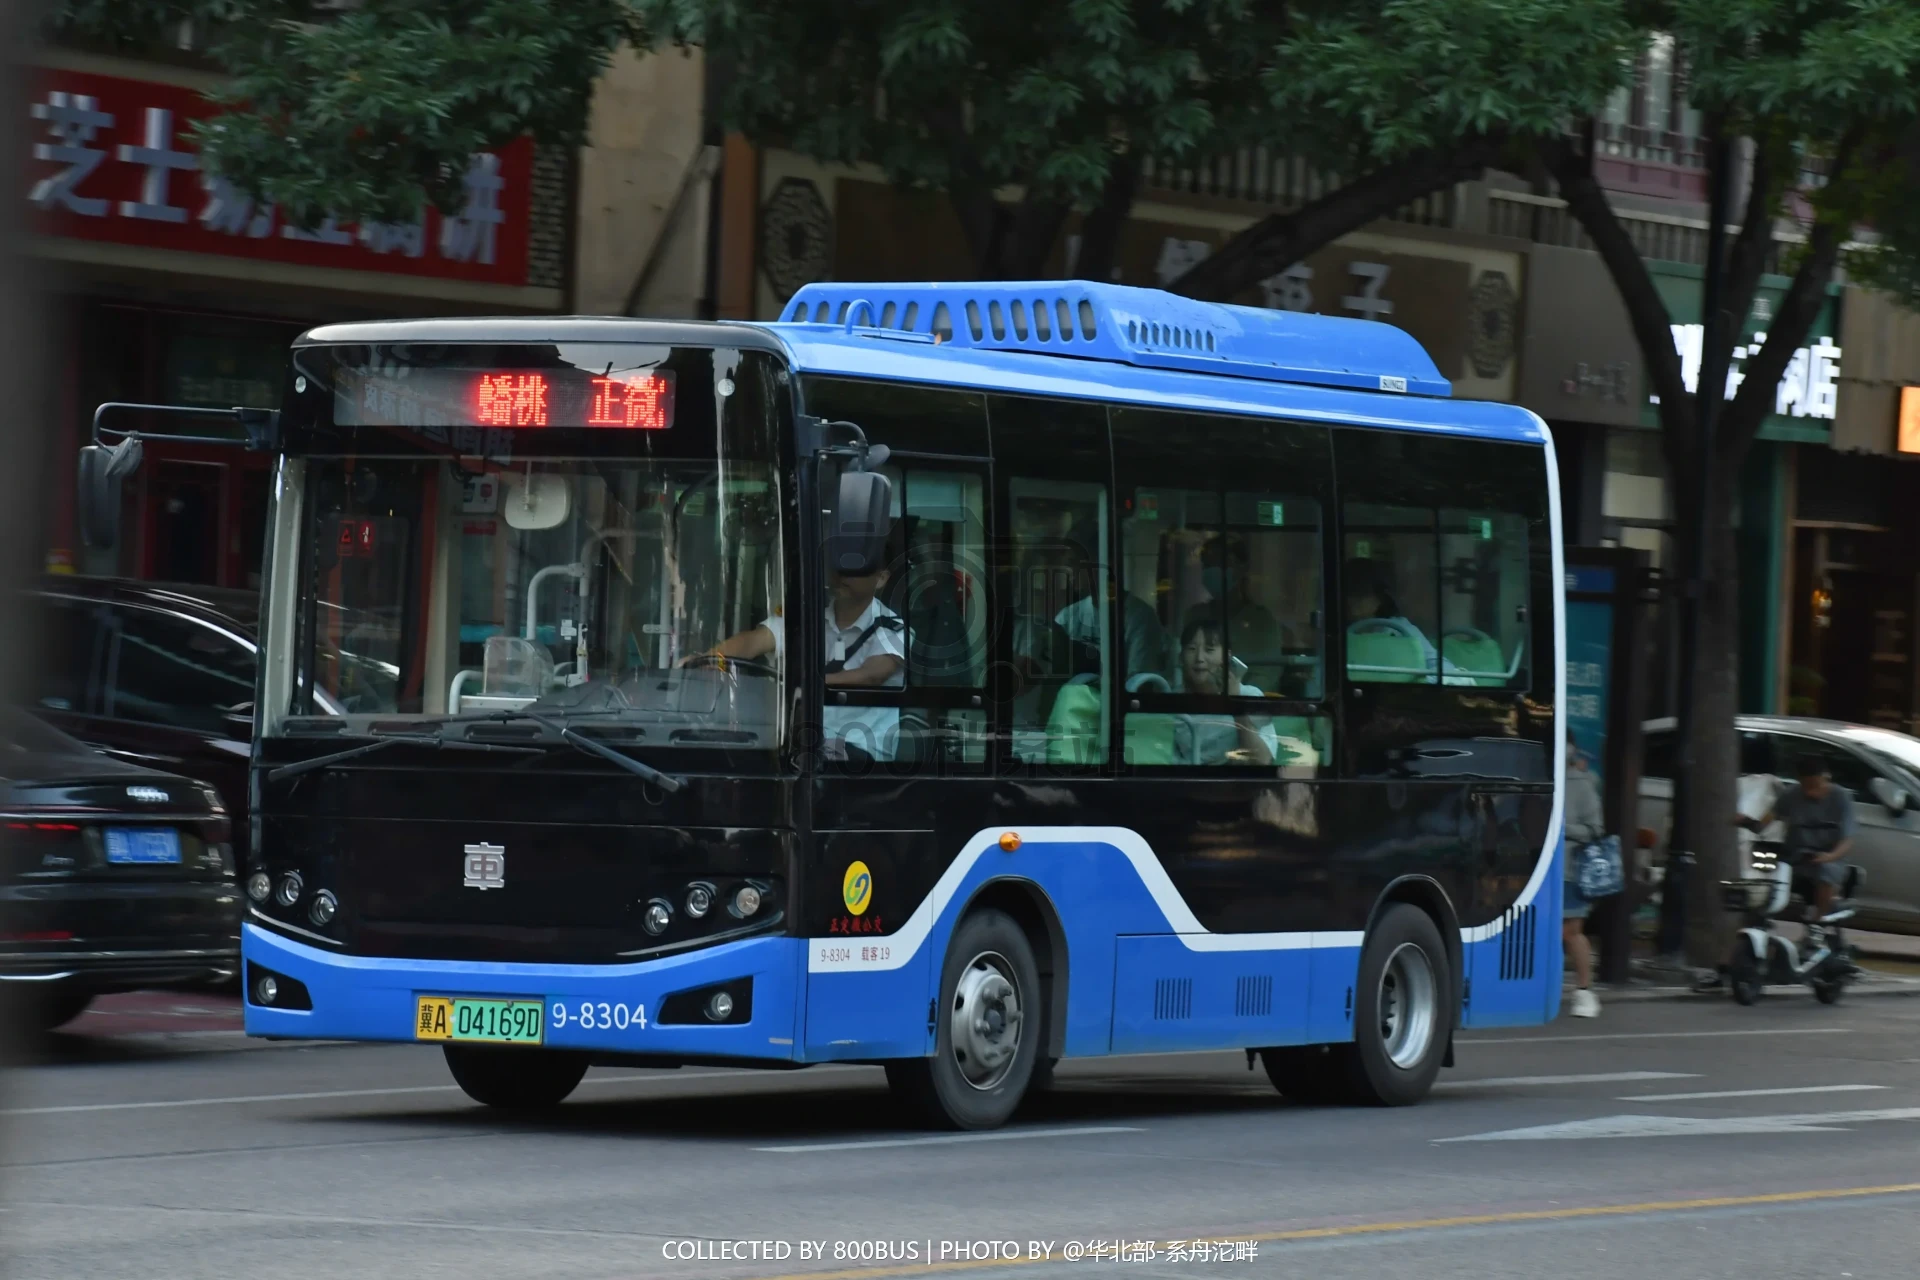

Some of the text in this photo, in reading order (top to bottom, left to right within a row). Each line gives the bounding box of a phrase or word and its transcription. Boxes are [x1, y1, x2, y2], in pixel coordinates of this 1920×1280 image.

[588, 376, 665, 427] 正微
[821, 948, 850, 962] 9-8304
[552, 1002, 648, 1030] 9-8304
